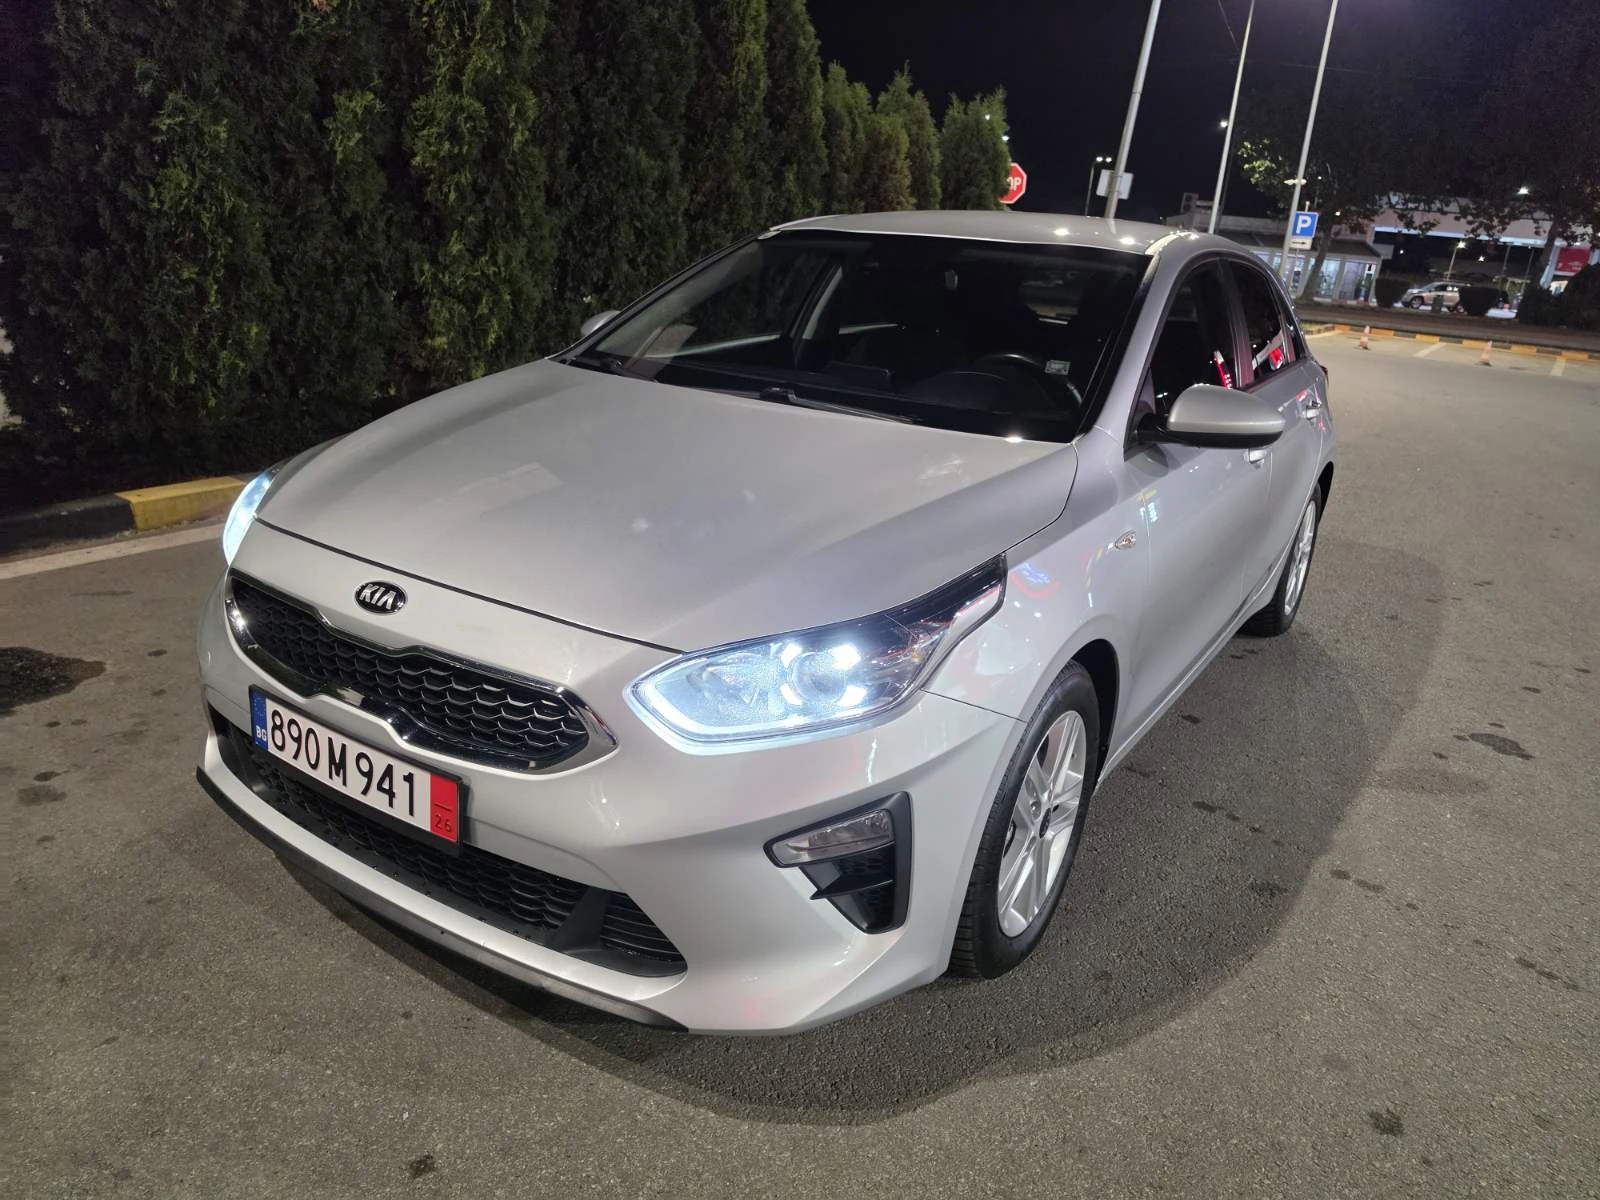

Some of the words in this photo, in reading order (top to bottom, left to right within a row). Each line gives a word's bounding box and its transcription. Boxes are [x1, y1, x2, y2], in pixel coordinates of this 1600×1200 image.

[1296, 215, 1312, 234] P
[359, 584, 396, 610] KIA
[255, 725, 267, 742] BG
[271, 709, 320, 770] 890
[328, 736, 348, 787] M
[355, 752, 415, 817] 941
[435, 813, 452, 833] 26
